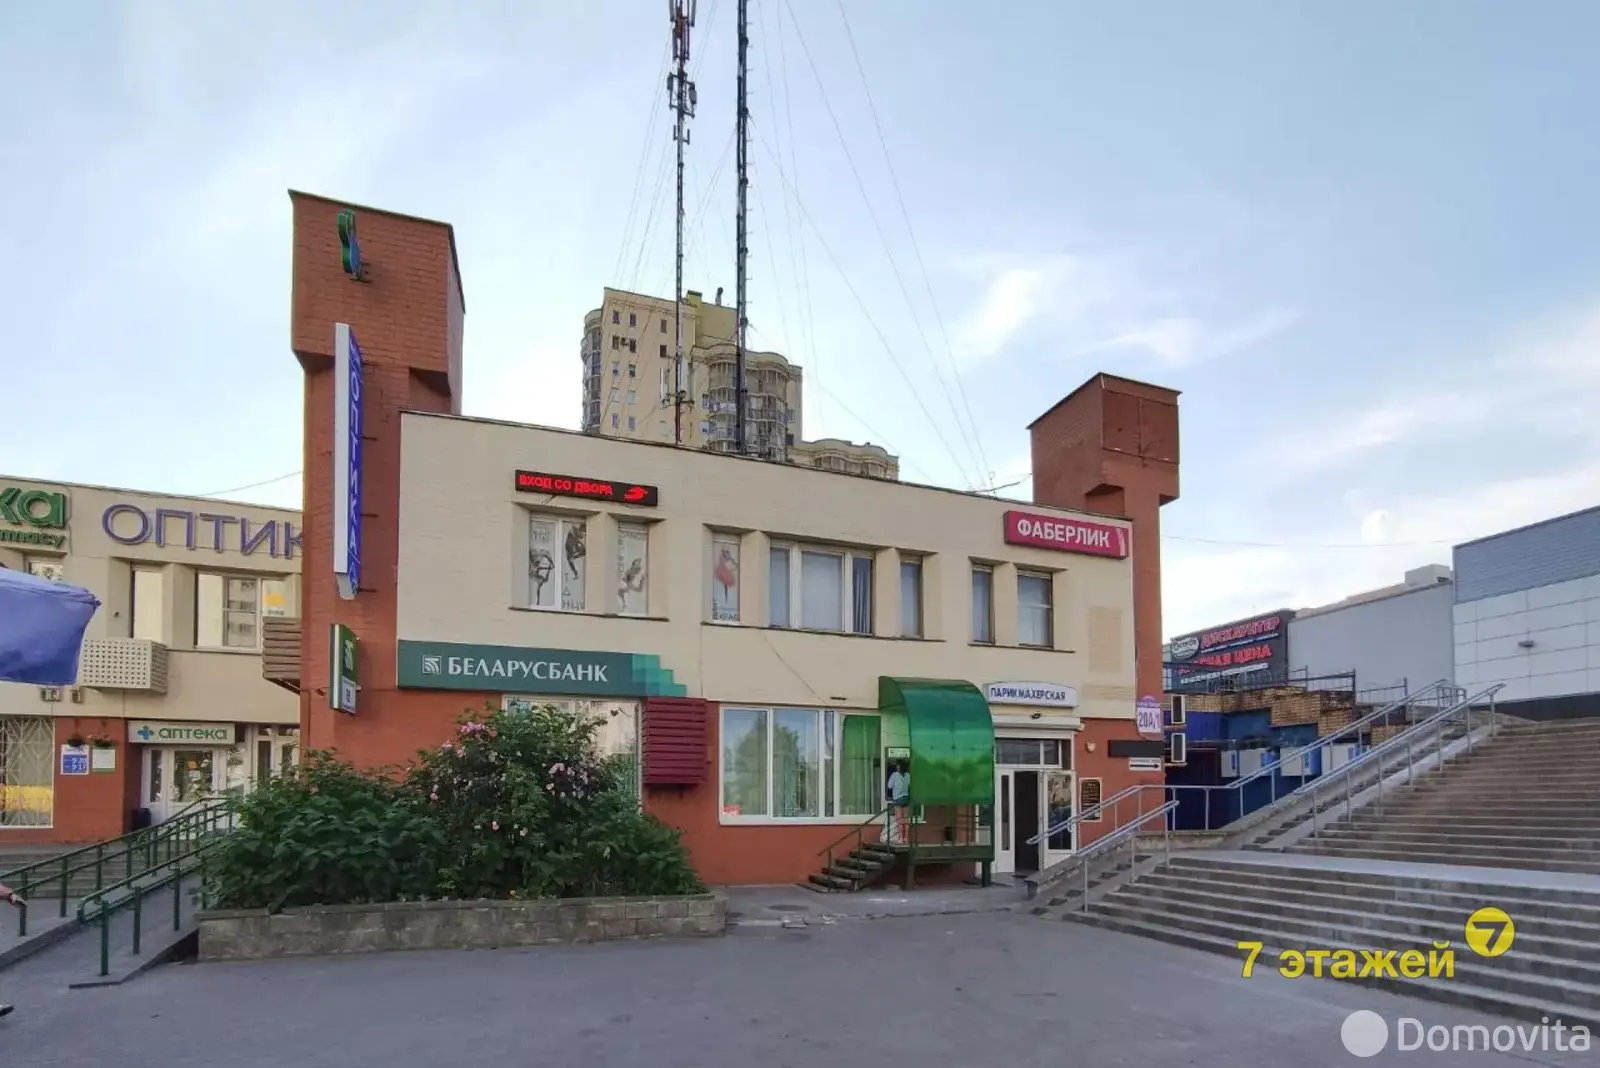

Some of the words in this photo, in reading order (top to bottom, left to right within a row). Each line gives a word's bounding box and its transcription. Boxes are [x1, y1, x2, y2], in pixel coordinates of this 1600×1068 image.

[519, 474, 552, 489] ВХОД
[554, 479, 571, 490] СО
[574, 481, 613, 496] ДВОРА
[1017, 518, 1110, 548] ФАБЕРЛИК
[448, 656, 608, 682] БЕЛАРУСБАНК
[159, 725, 227, 741] аптека
